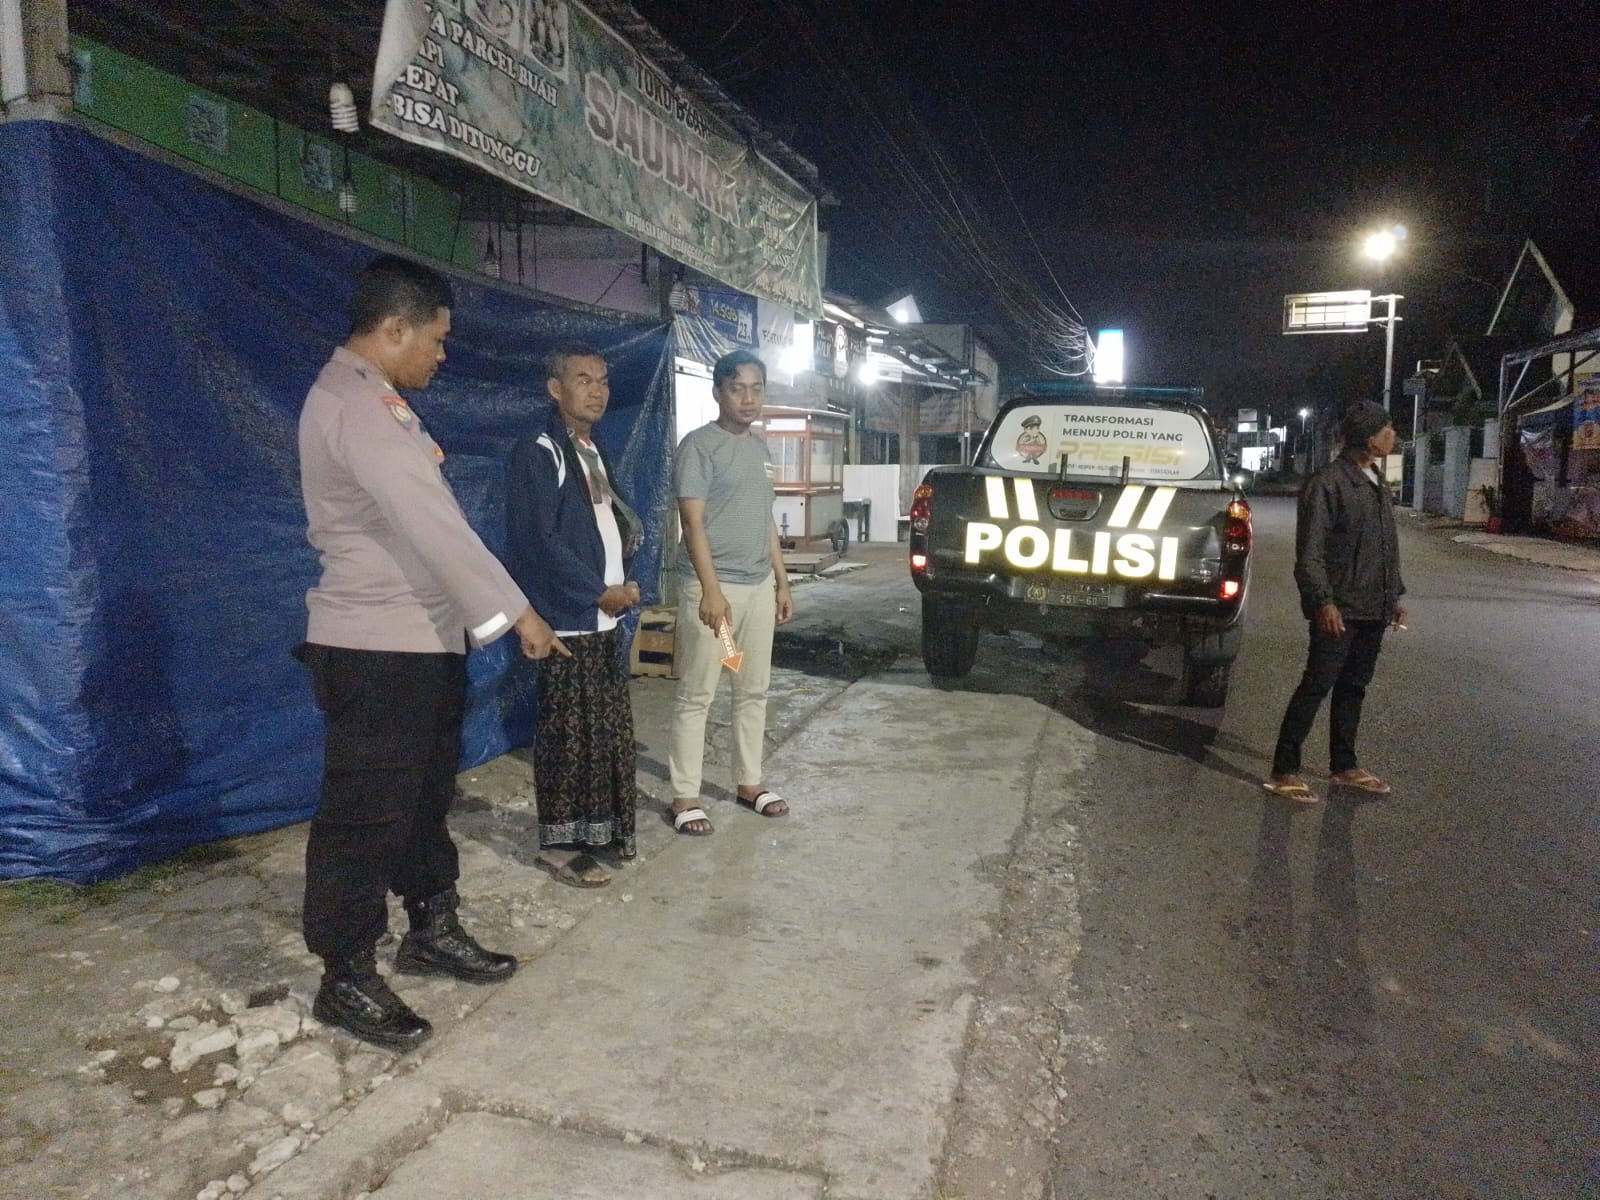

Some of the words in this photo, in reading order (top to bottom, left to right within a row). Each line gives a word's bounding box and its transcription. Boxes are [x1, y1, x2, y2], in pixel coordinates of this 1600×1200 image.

[450, 20, 516, 79] PARCEL
[519, 63, 557, 107] BUAH
[393, 94, 448, 133] BISA
[448, 116, 541, 177] DITUNGGU
[585, 71, 741, 229] SAUDARA
[1062, 428, 1110, 438] MENUJU
[1112, 430, 1148, 440] POLRI
[1151, 431, 1183, 442] YANG
[1064, 414, 1154, 426] TRANSFORMASI
[965, 521, 1179, 580] POLISI
